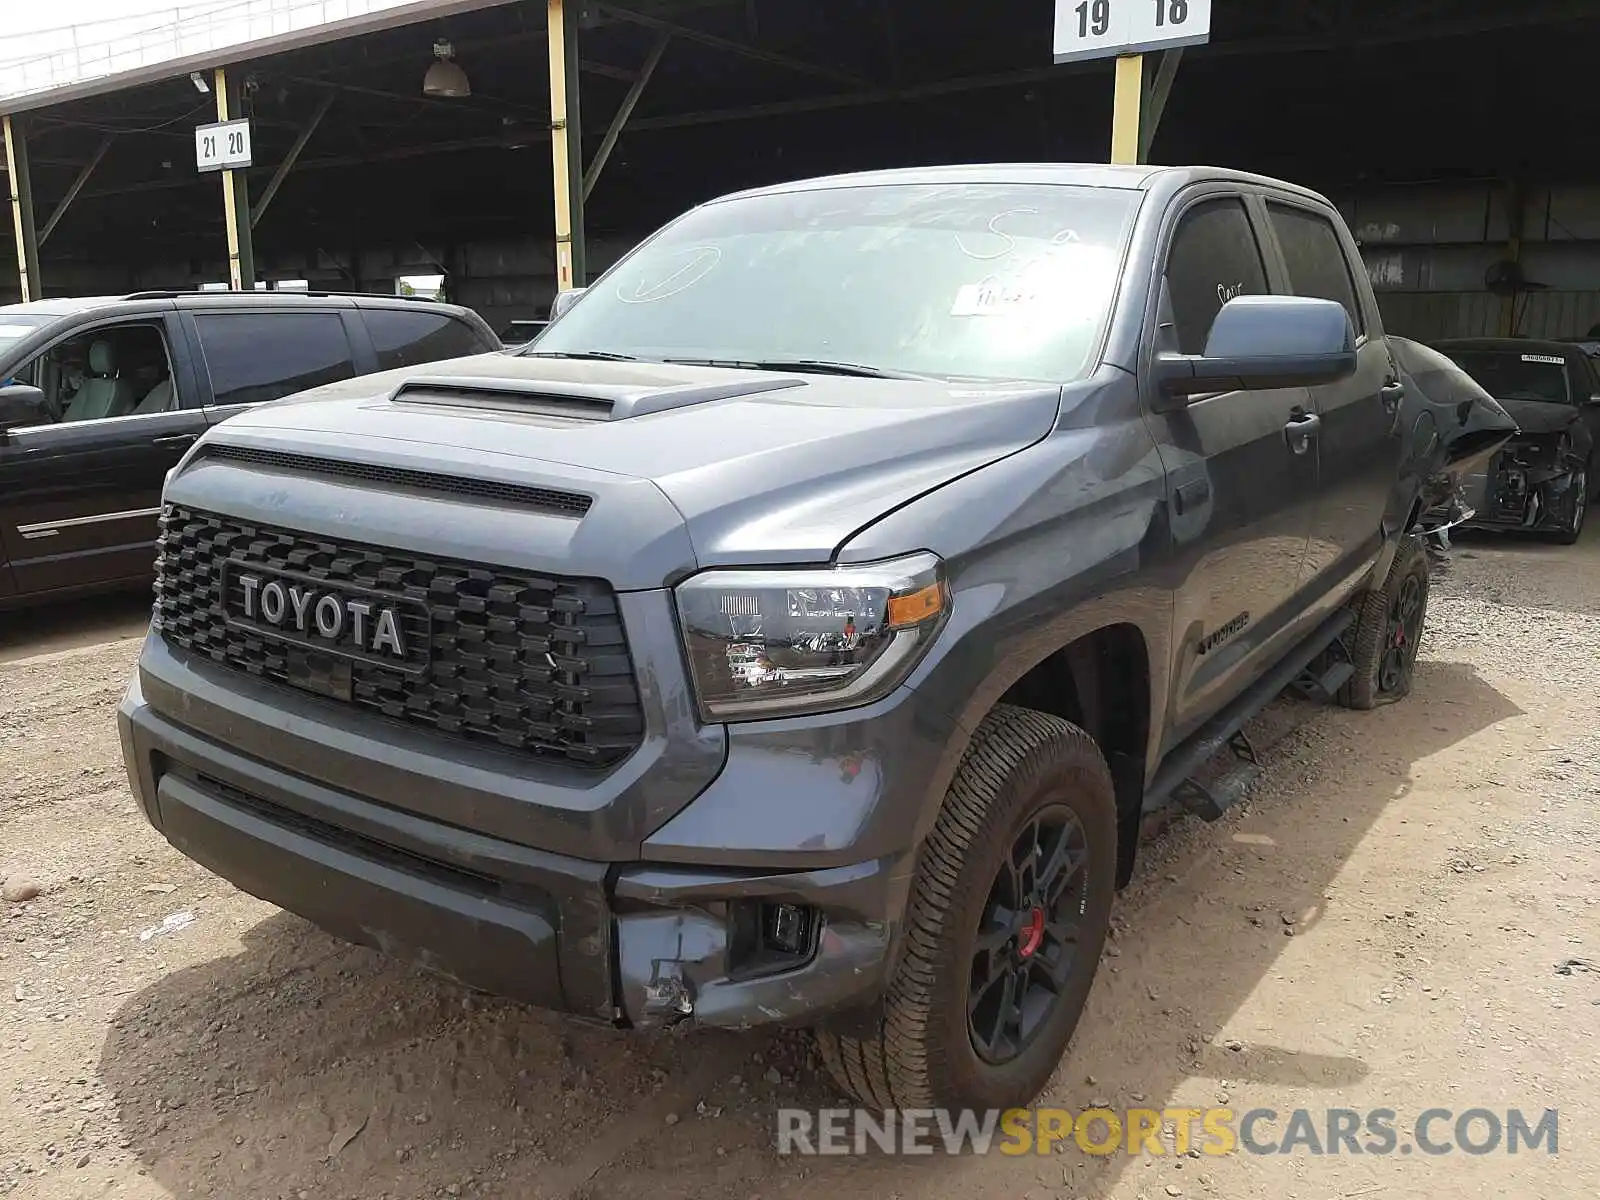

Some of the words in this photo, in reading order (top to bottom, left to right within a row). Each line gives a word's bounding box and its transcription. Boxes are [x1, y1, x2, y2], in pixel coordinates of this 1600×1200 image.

[1075, 0, 1109, 37] 19
[1153, 0, 1188, 26] 18
[203, 135, 216, 158] 21
[228, 131, 244, 155] 20
[239, 575, 402, 656] TOYOTA
